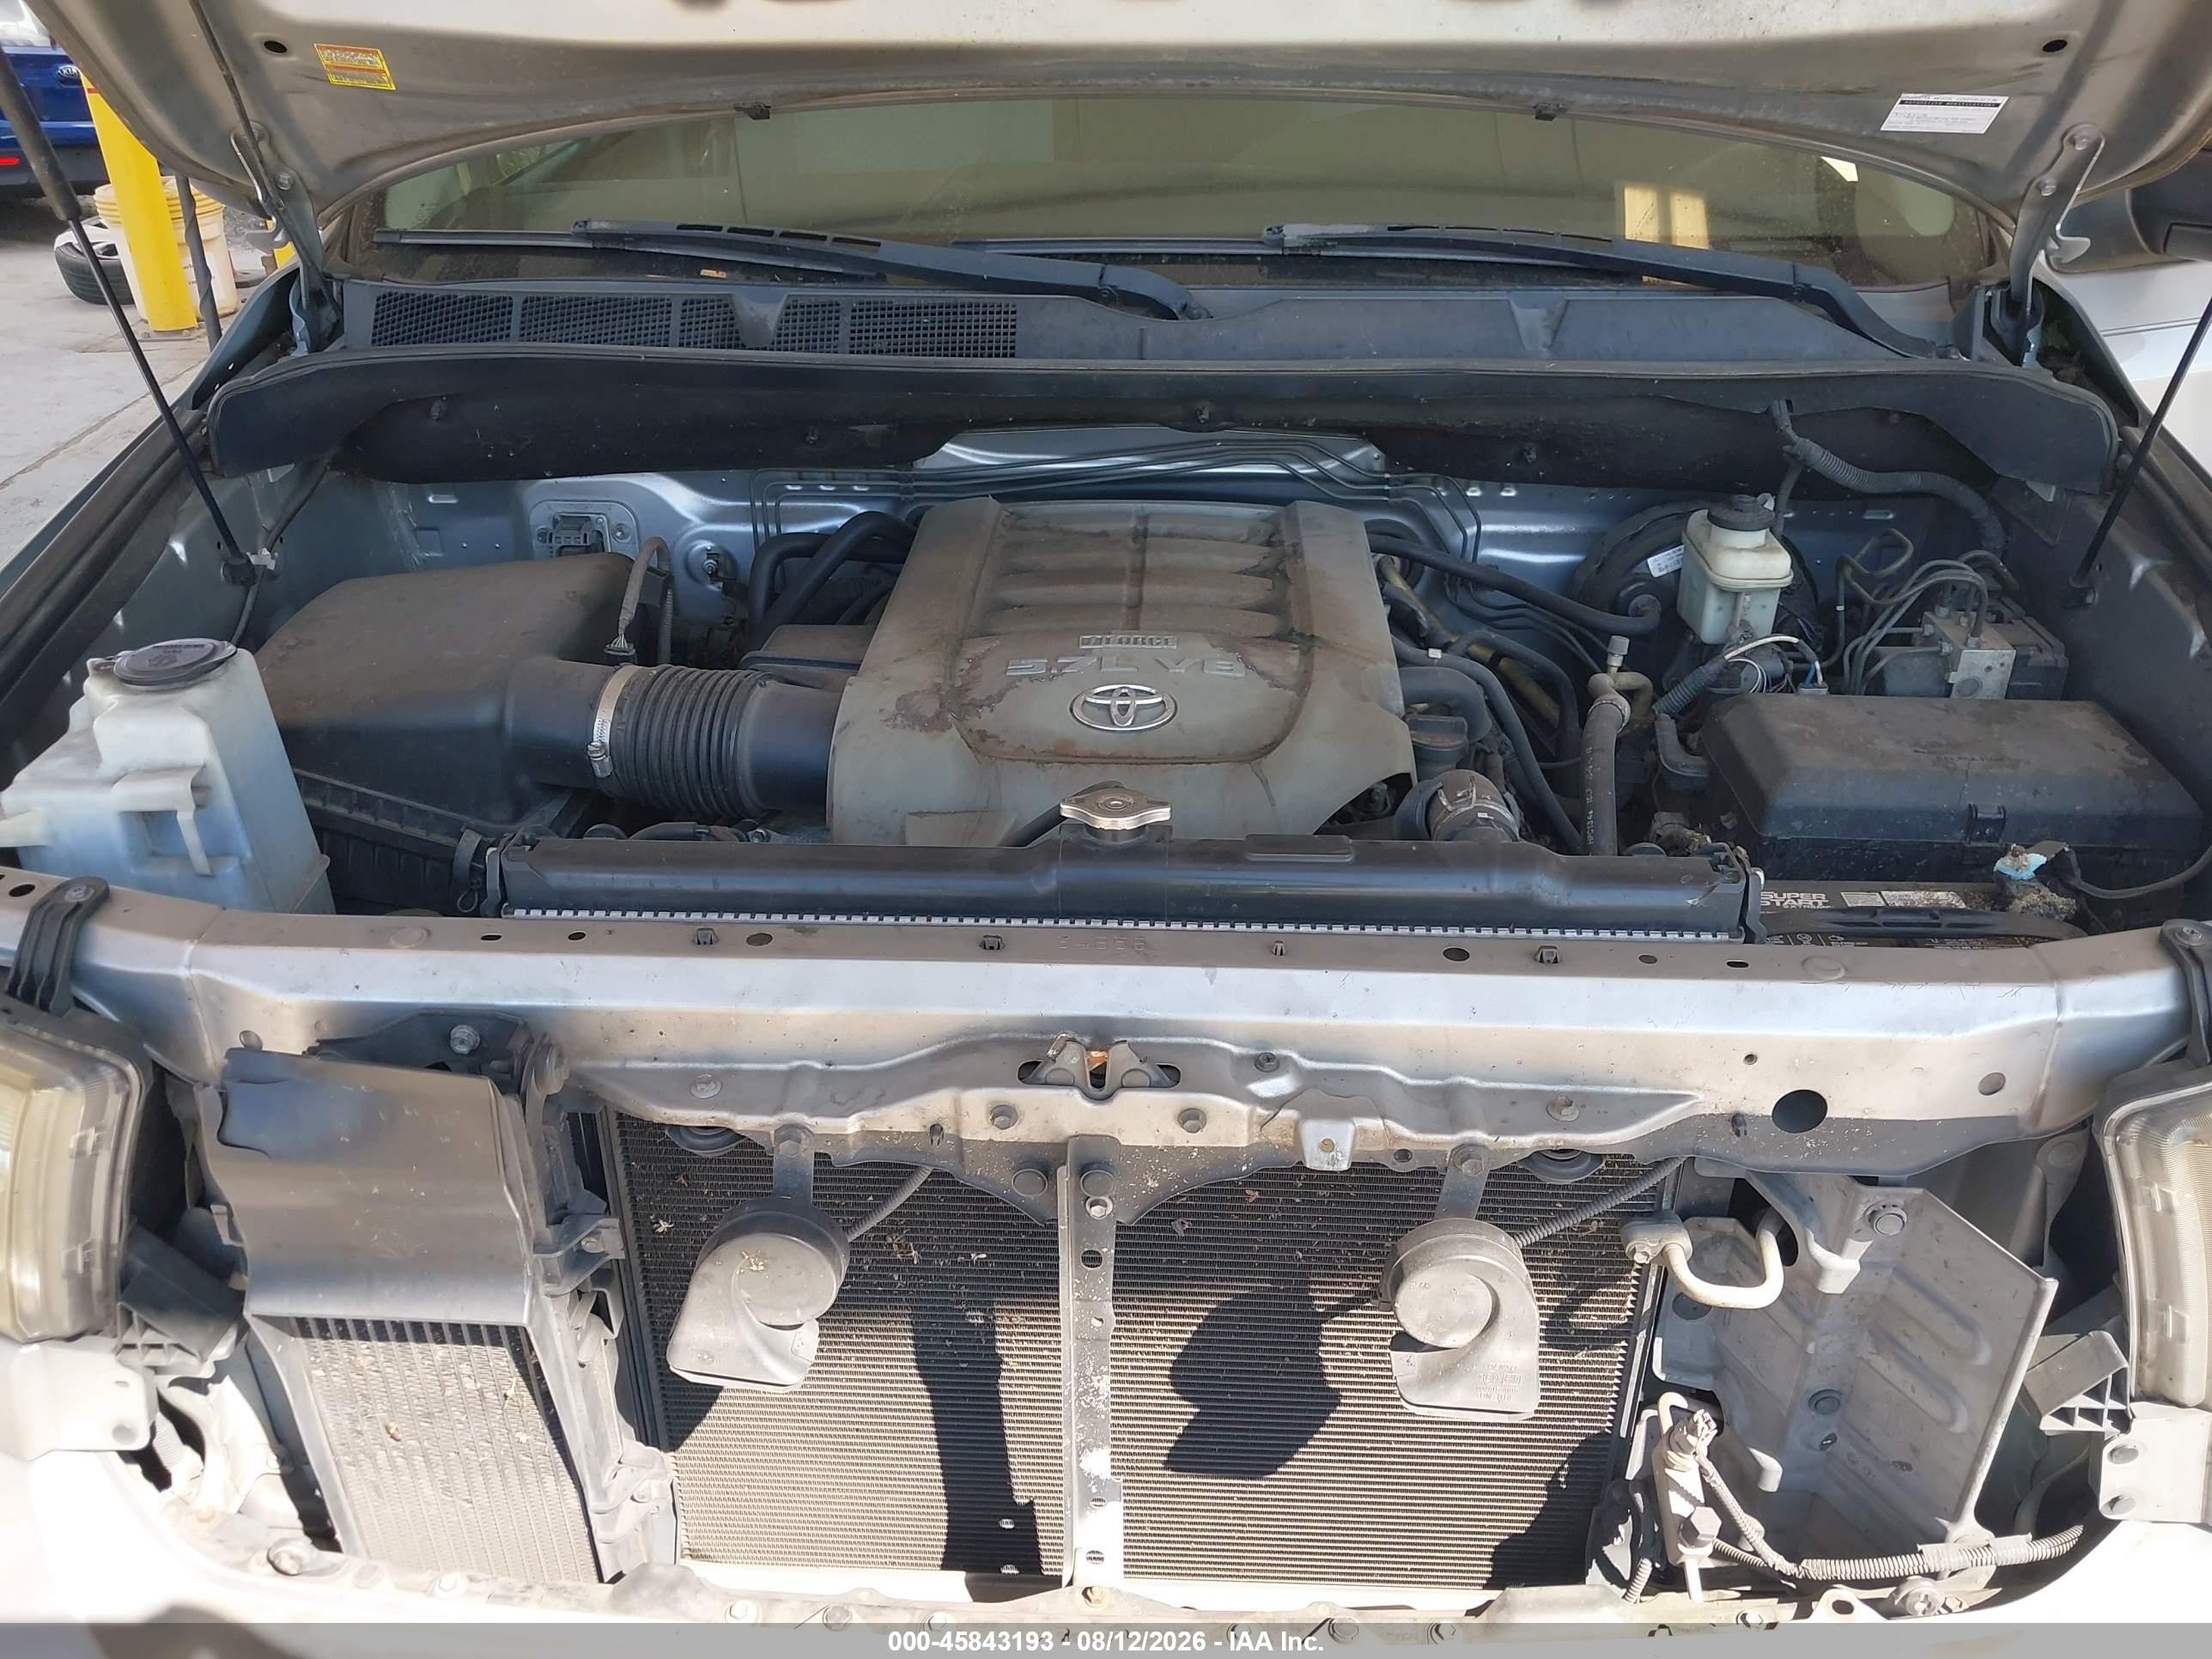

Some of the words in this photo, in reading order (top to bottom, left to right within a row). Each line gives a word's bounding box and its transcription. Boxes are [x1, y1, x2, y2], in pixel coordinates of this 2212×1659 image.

[1006, 655, 1139, 676] 5.7L
[1154, 658, 1246, 678] V8
[1760, 891, 1826, 900] SUPER
